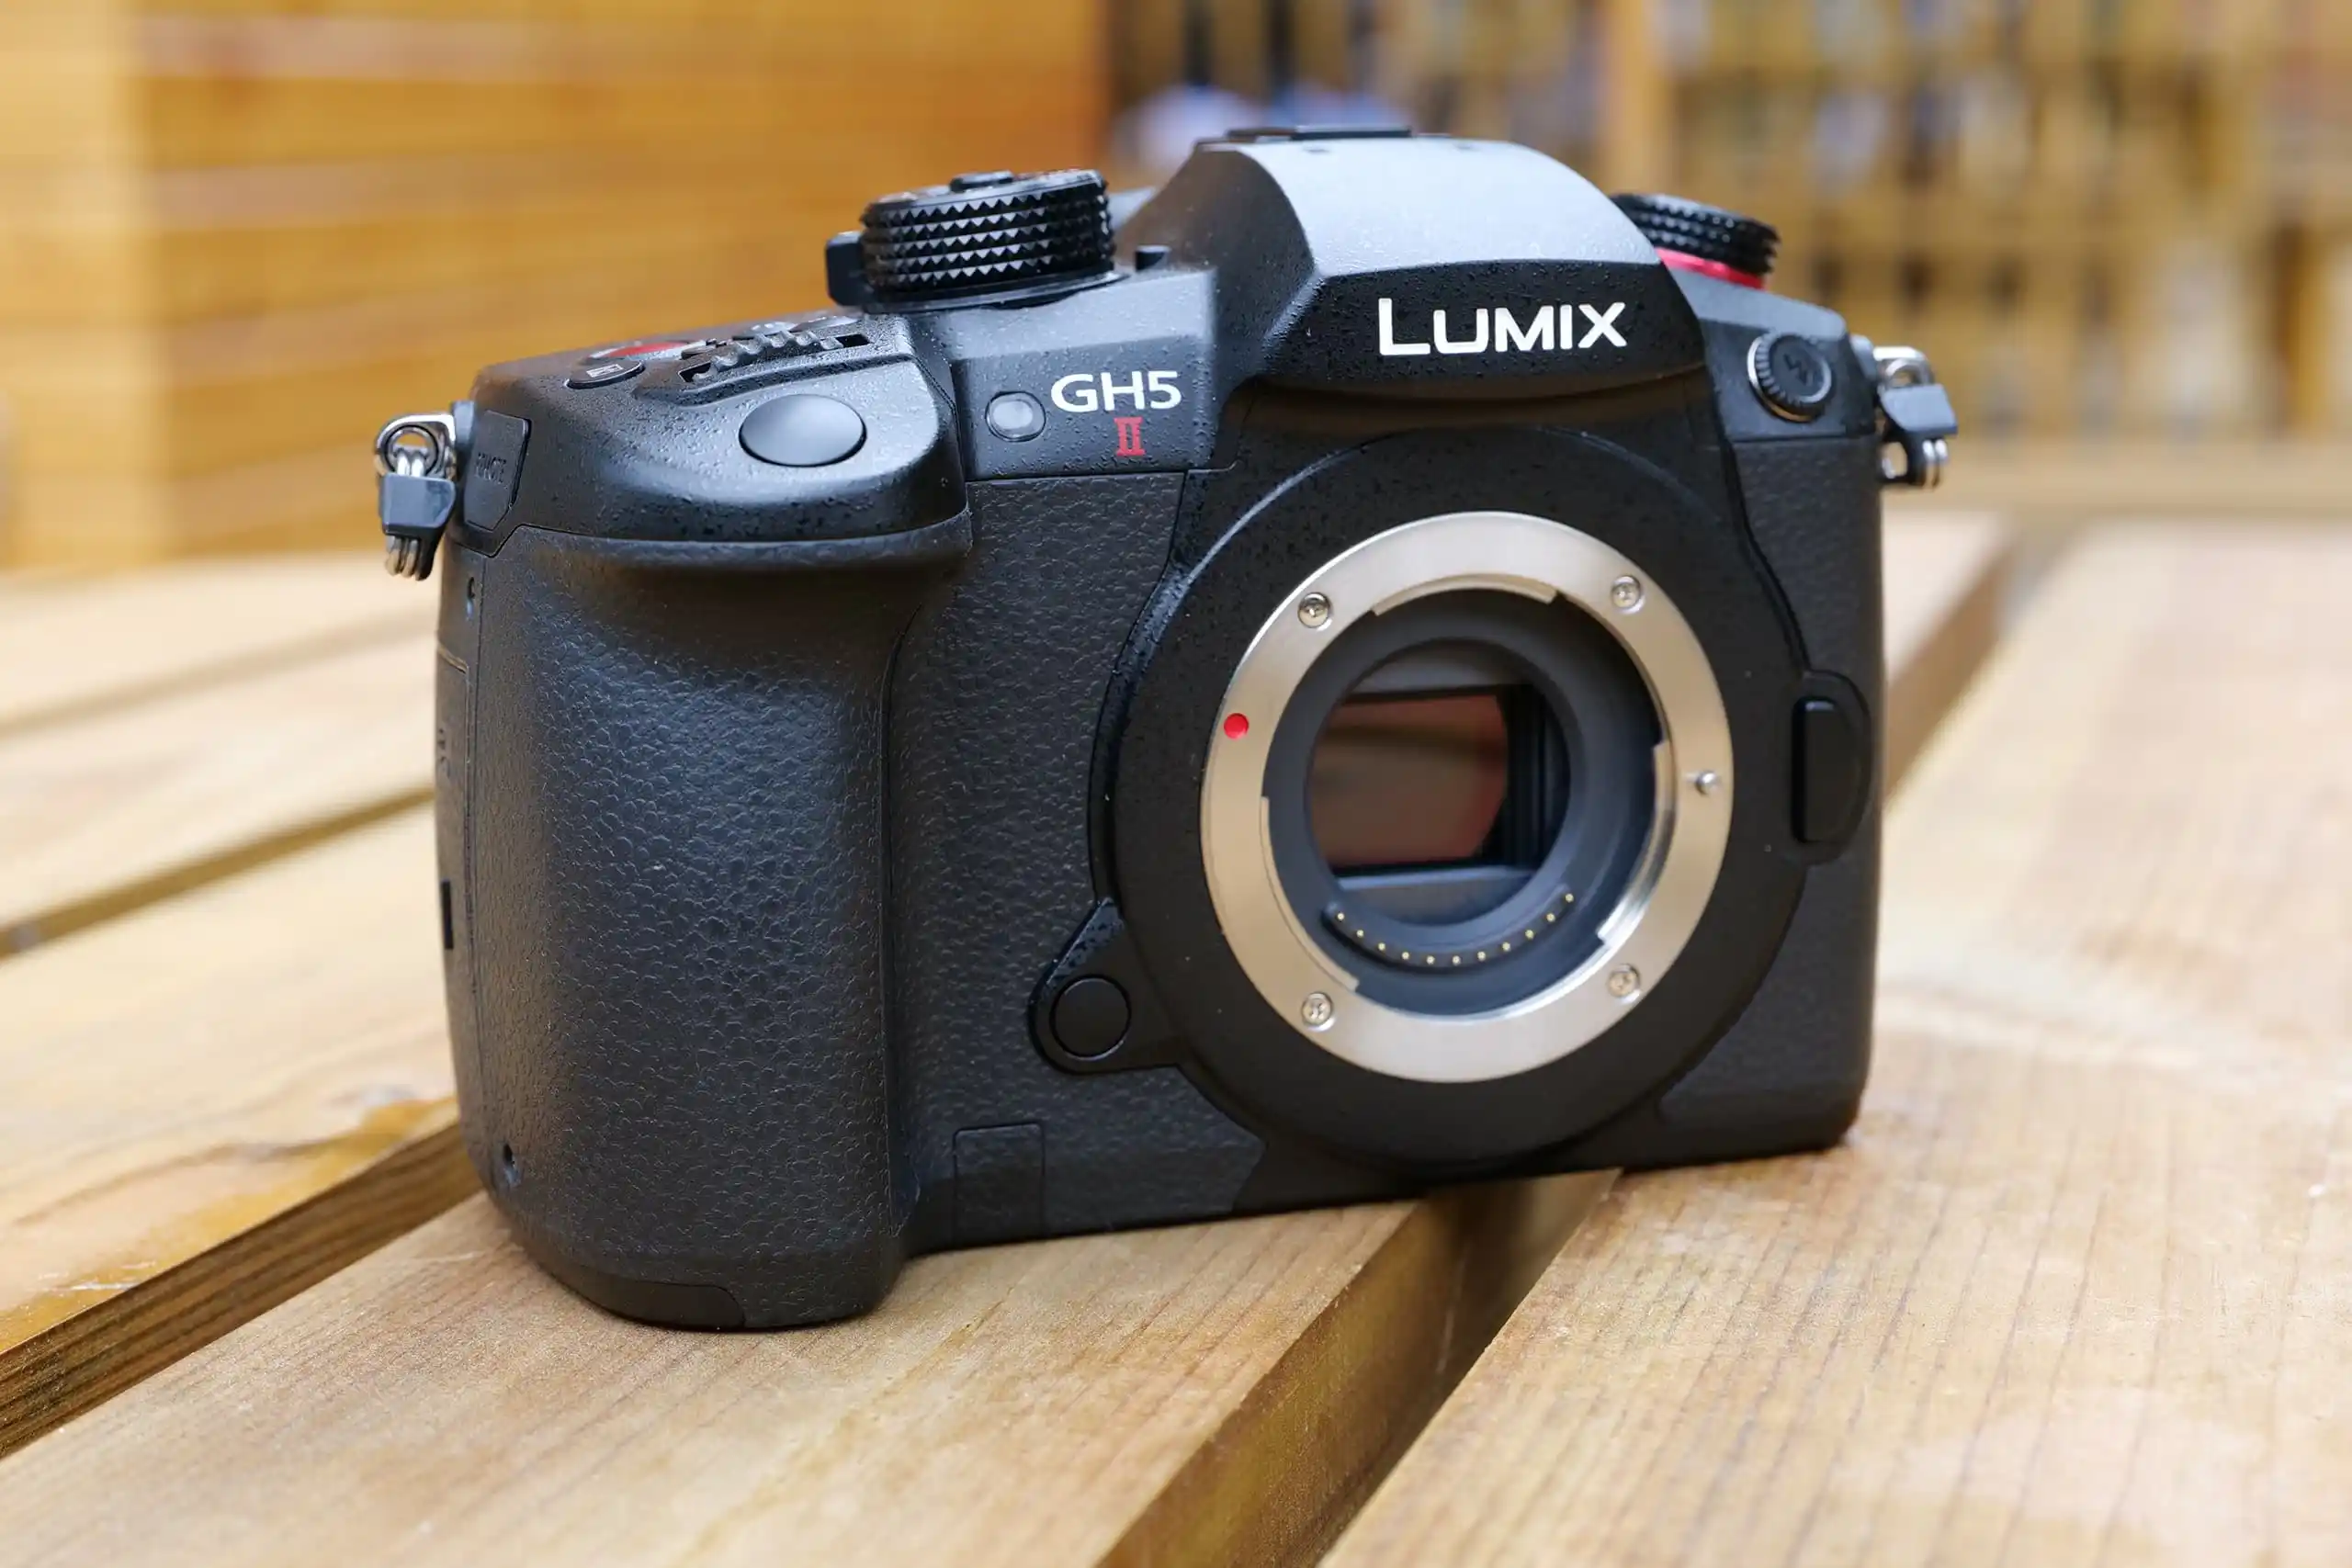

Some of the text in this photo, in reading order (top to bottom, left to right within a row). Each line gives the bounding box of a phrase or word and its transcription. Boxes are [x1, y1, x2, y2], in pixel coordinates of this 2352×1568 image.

[1378, 298, 1627, 355] LUMIX
[1051, 370, 1182, 412] GH5
[1114, 416, 1146, 457] II
